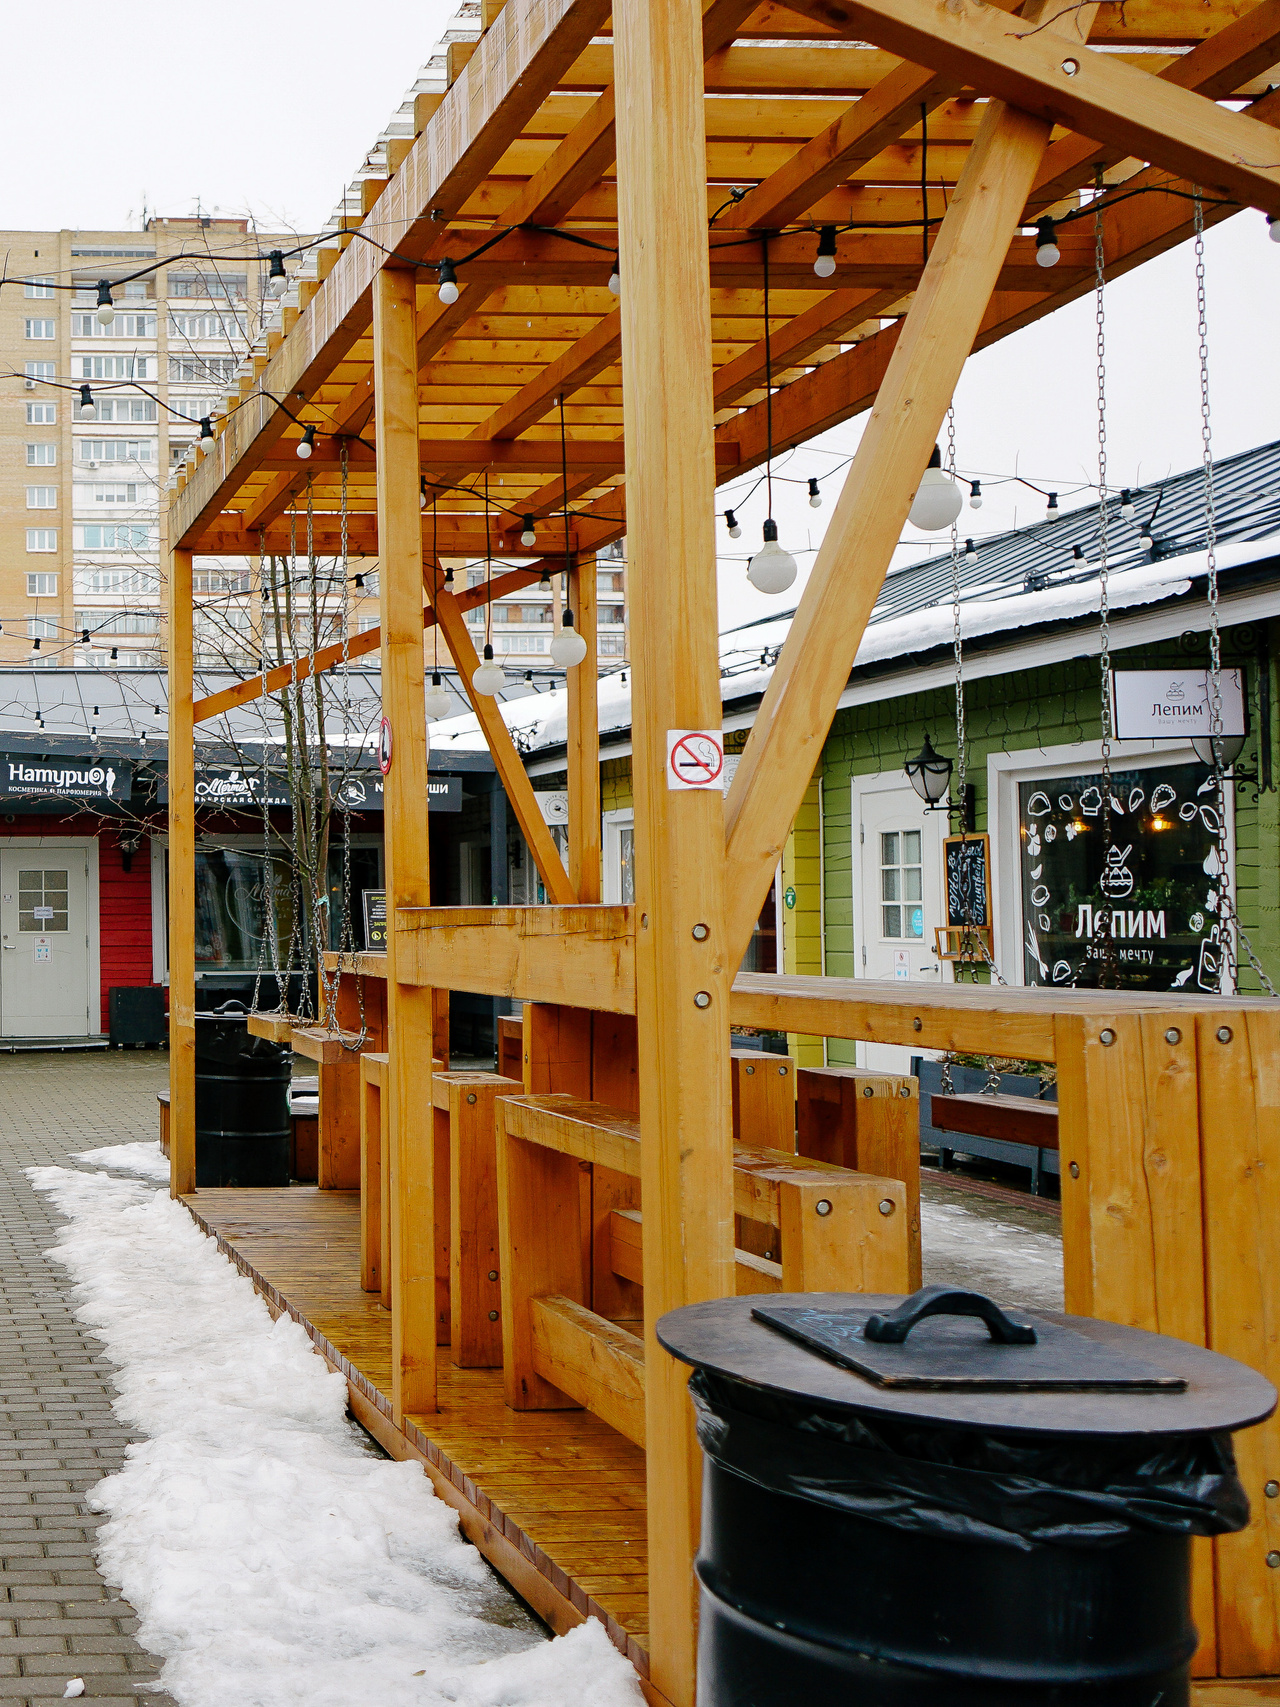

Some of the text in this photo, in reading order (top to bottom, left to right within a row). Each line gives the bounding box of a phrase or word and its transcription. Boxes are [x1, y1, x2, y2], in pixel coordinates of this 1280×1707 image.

[1151, 703, 1203, 716] Лепим
[1075, 904, 1166, 938] Лепим
[1119, 949, 1154, 965] мечту
